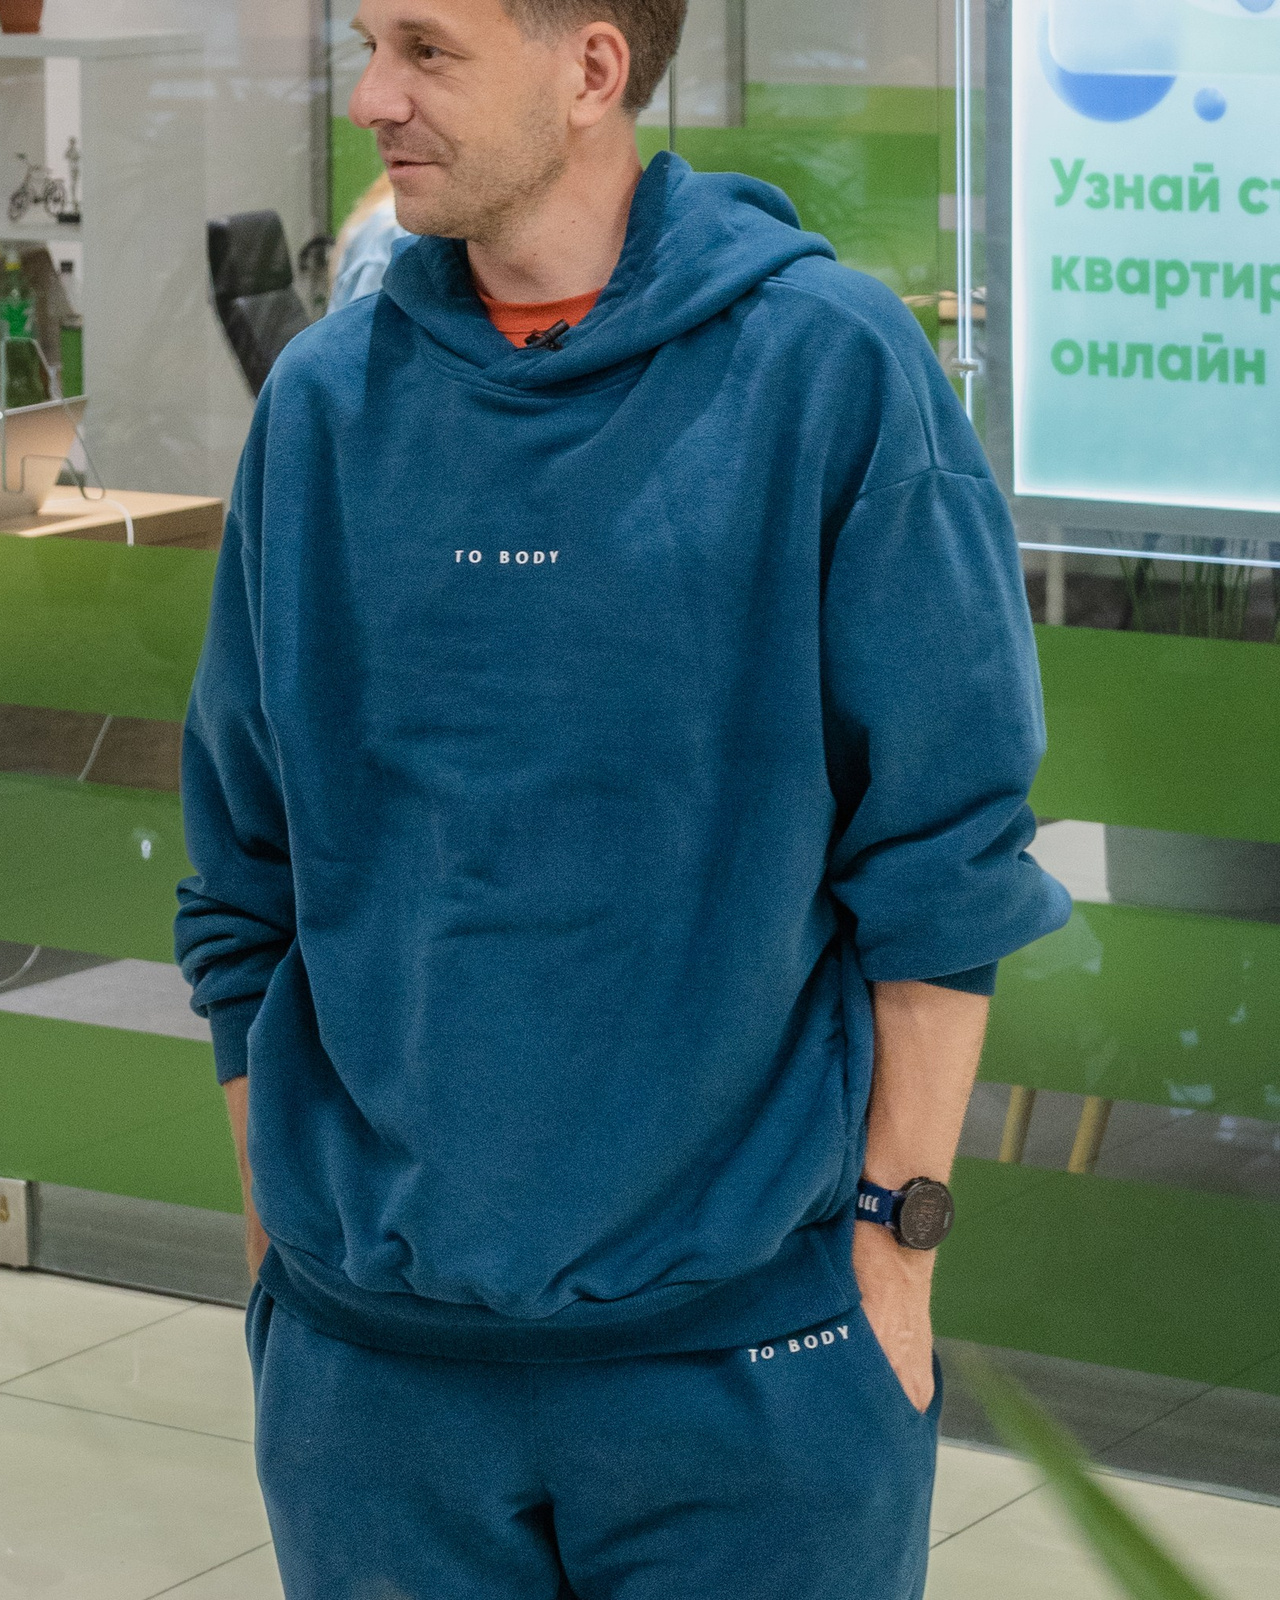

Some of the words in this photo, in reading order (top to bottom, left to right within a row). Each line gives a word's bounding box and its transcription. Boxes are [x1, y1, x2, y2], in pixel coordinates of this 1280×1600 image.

[1049, 157, 1220, 212] Узнай
[1050, 333, 1267, 385] онлайн
[455, 550, 482, 563] TO
[499, 550, 559, 564] BODY
[748, 1346, 775, 1363] TO
[788, 1325, 850, 1353] BODY
